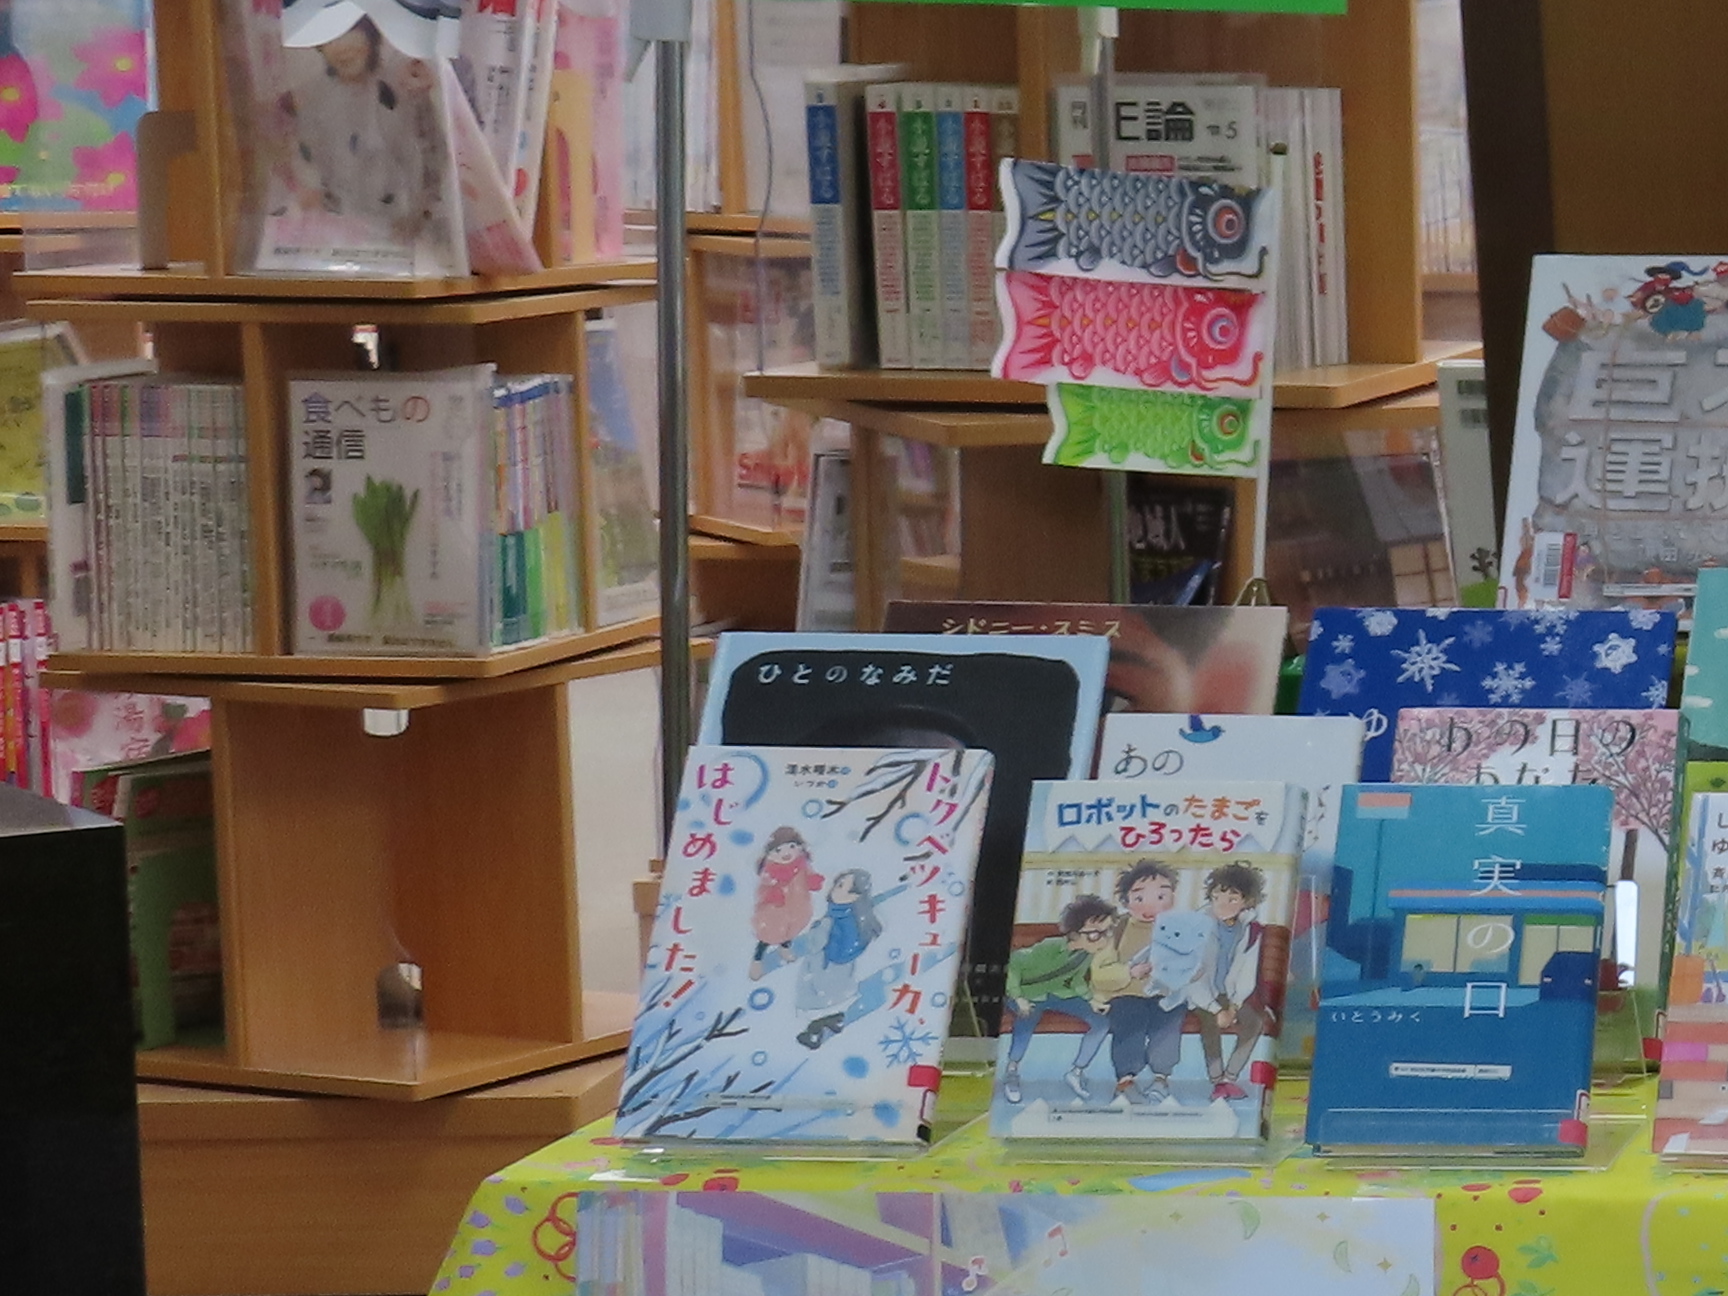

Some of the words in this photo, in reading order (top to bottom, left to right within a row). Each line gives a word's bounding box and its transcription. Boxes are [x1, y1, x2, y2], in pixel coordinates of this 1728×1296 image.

[300, 391, 431, 425] 食べもの
[302, 428, 366, 461] 通信
[758, 661, 954, 687] ひとのなみだ
[1113, 743, 1185, 779] あの
[1056, 793, 1270, 828] ロボットのたまごを
[1119, 821, 1242, 852] ひろったら
[1462, 795, 1528, 1020] 真実の口
